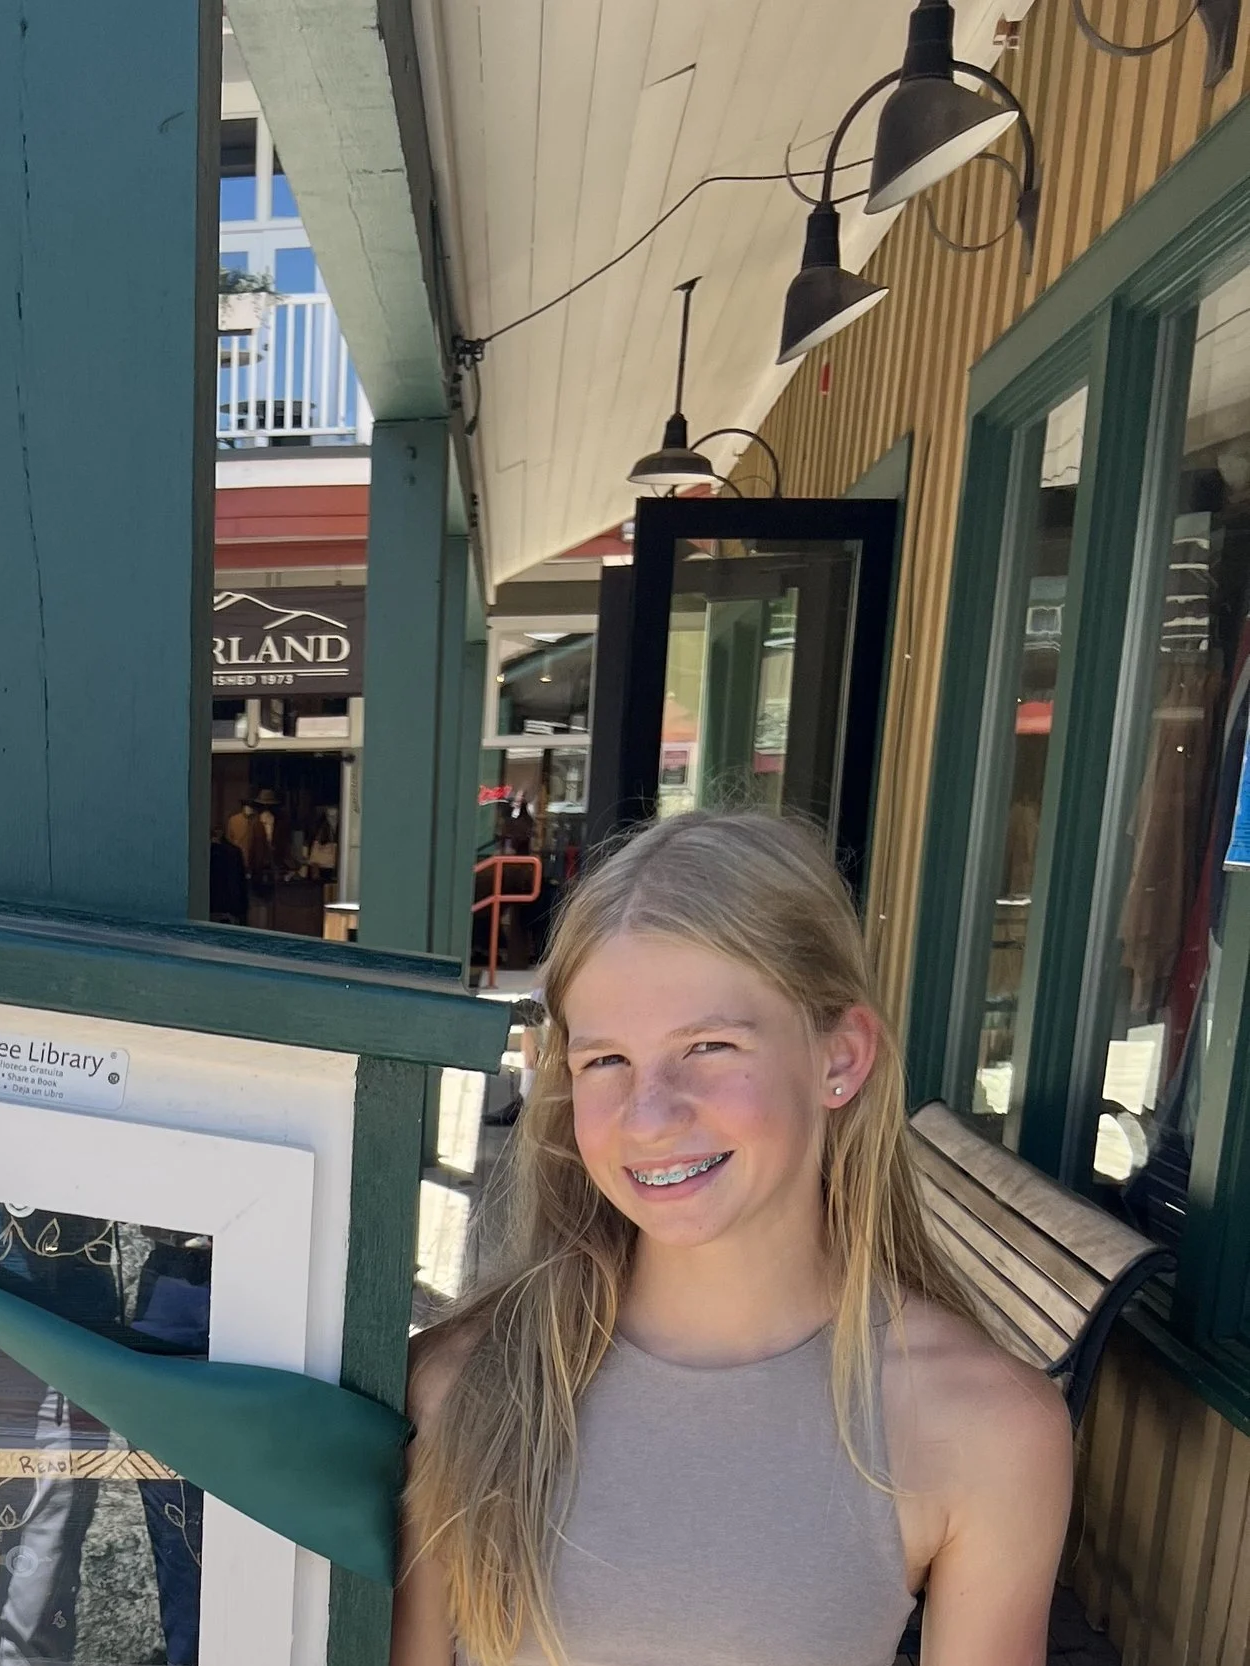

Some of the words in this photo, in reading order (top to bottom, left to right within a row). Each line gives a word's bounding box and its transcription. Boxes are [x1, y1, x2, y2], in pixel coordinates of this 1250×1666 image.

[260, 675, 294, 685] 1973
[28, 1041, 104, 1077] Library
[29, 1064, 64, 1078] Gratuita
[7, 1072, 29, 1084] Share
[37, 1076, 57, 1088] Book
[12, 1083, 30, 1096] Deja
[32, 1087, 42, 1096] un
[18, 1452, 74, 1475] READ!
